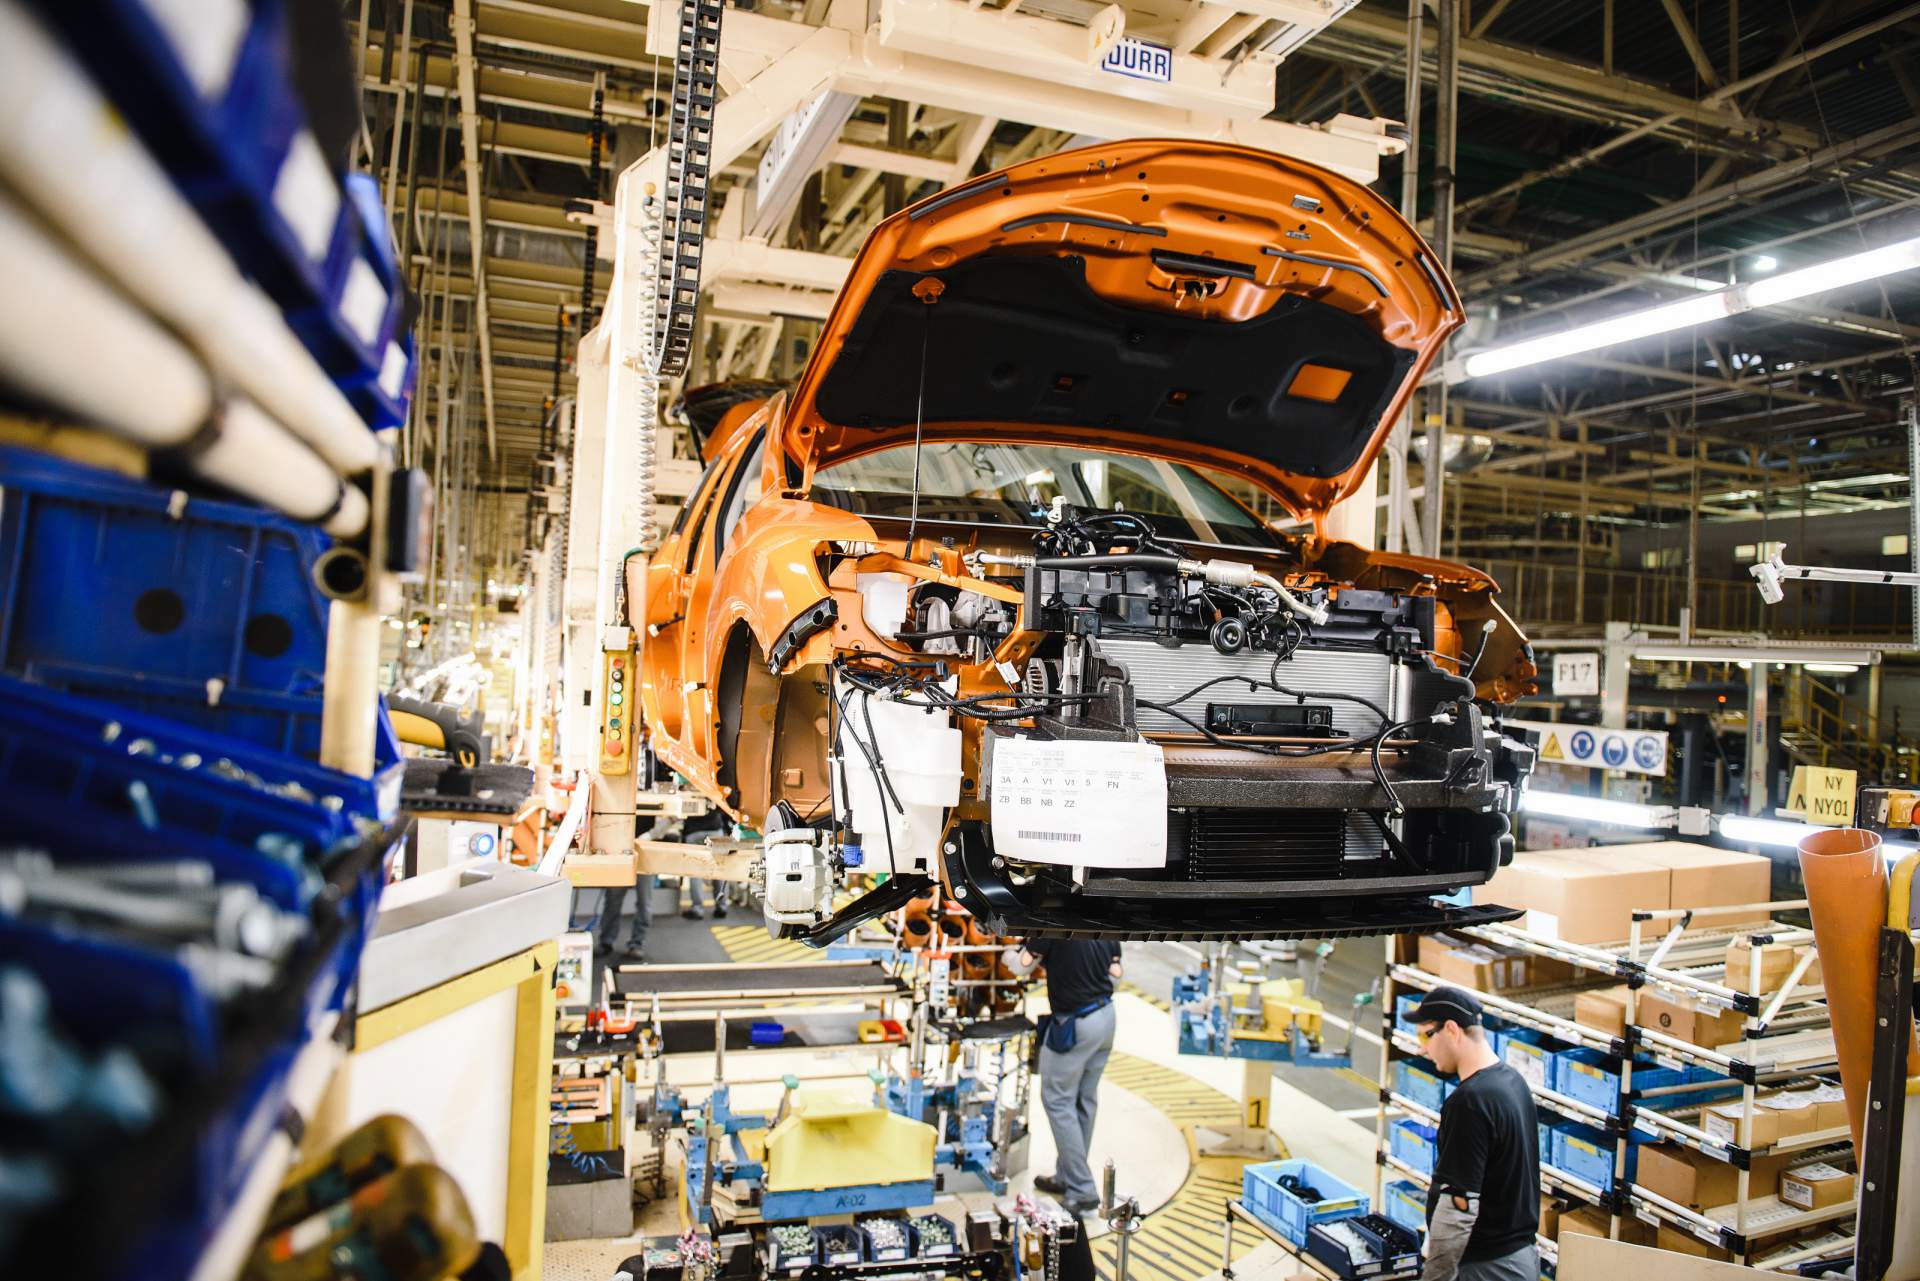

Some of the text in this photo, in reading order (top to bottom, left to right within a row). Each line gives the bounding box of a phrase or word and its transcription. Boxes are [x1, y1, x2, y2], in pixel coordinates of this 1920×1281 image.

[1559, 662, 1592, 682] F17
[1107, 781, 1119, 789] FN
[1825, 775, 1843, 791] NY
[1064, 799, 1075, 808] ZZ
[1814, 797, 1848, 817] NY01
